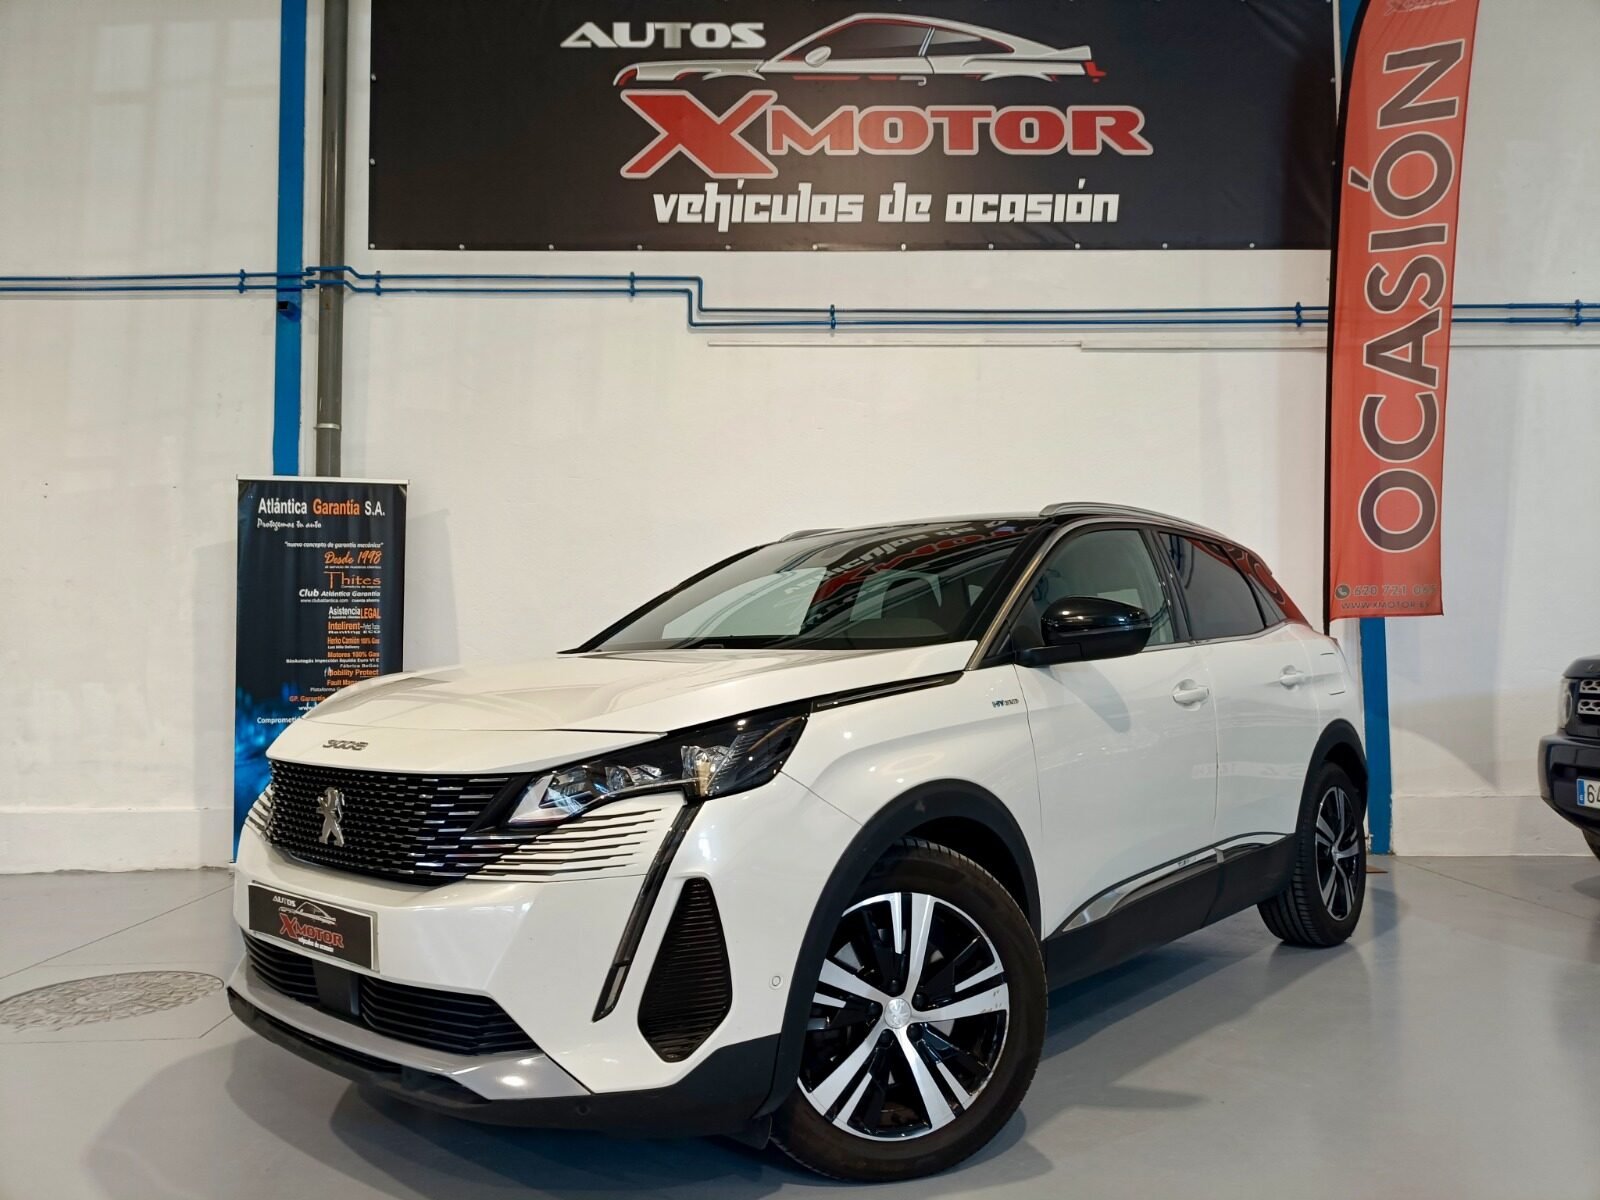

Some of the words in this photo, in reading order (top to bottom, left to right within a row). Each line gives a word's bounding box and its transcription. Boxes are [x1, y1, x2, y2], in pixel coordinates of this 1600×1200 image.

[560, 22, 766, 49] AUTOS
[620, 89, 1153, 178] XMOTOR
[653, 179, 864, 232] vehículos
[877, 182, 931, 223] de
[944, 179, 1119, 223] ocasión
[1347, 38, 1466, 553] OCASIÓN
[258, 497, 308, 515] Atlántica
[313, 498, 360, 516] Garantía
[364, 500, 386, 516] S.A.
[324, 551, 354, 565] Desde
[357, 550, 382, 565] 1998
[298, 588, 320, 597] Club
[272, 895, 297, 907] AUTOS
[279, 912, 345, 949] XMOTOR
